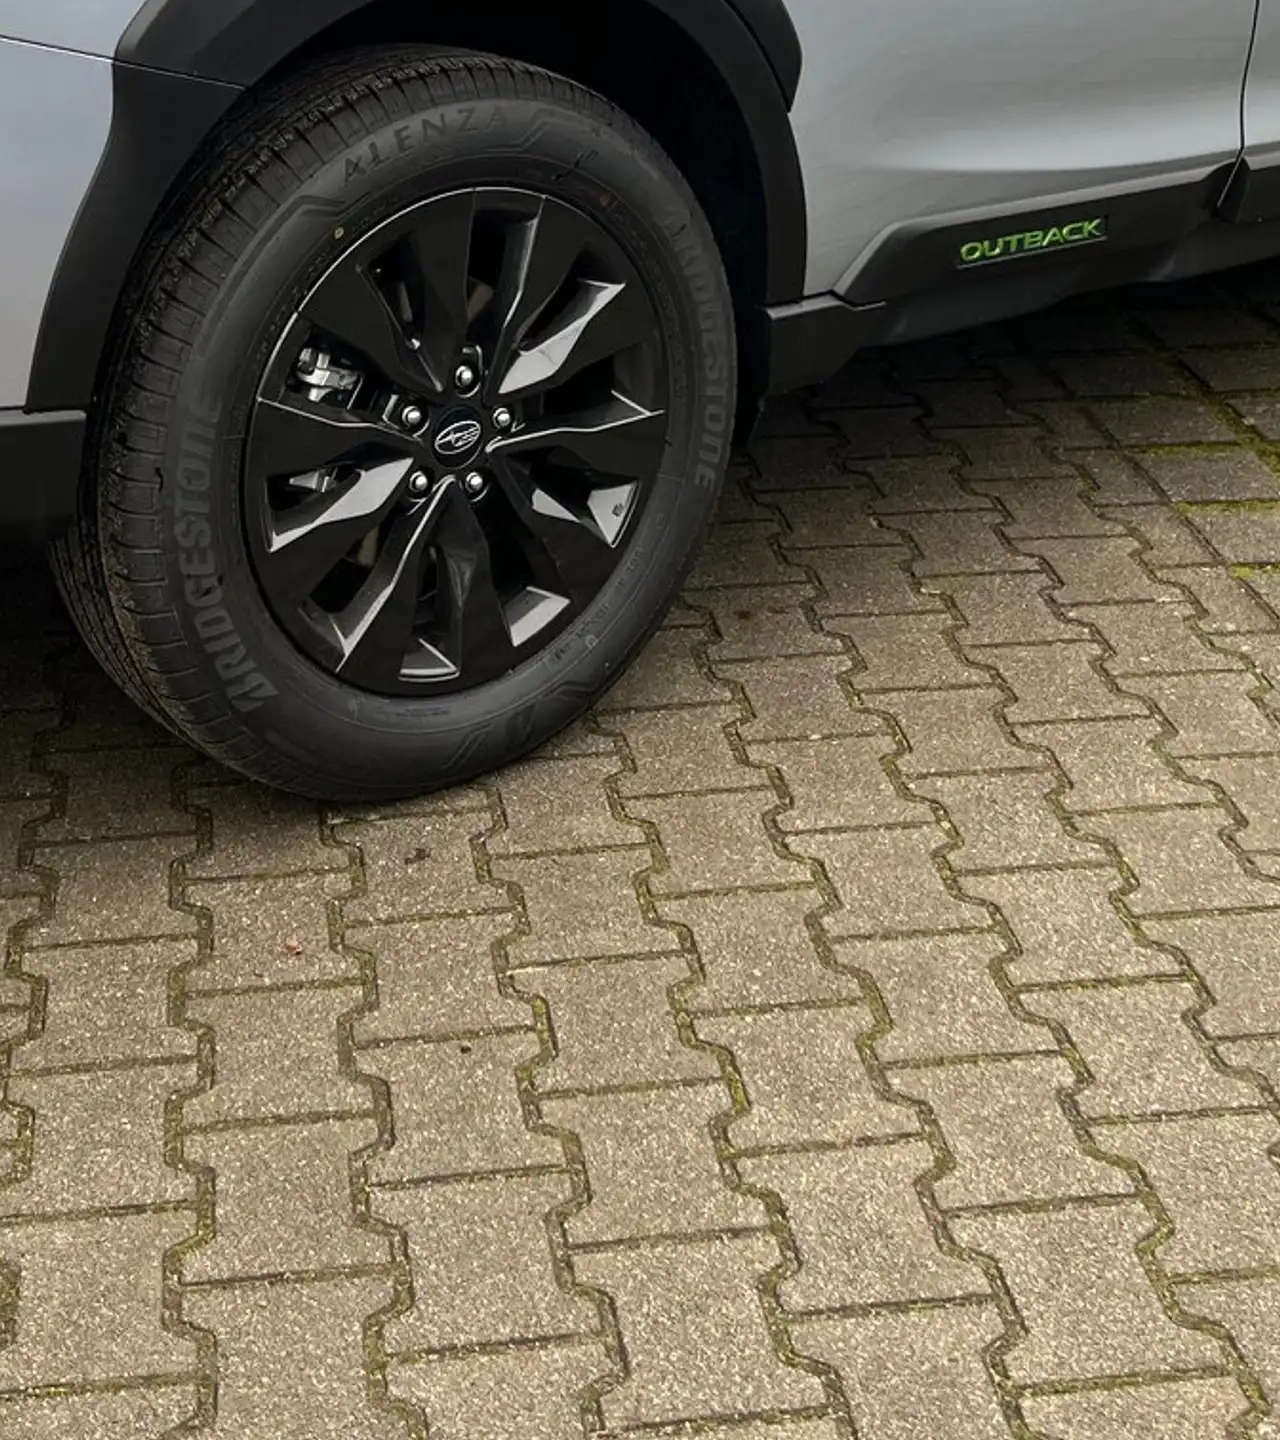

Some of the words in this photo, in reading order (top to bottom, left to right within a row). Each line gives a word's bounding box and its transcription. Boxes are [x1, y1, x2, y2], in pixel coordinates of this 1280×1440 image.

[341, 104, 508, 186] ALENZA
[959, 217, 1105, 262] OUTBACK
[172, 388, 281, 715] BRIDGESTONE
